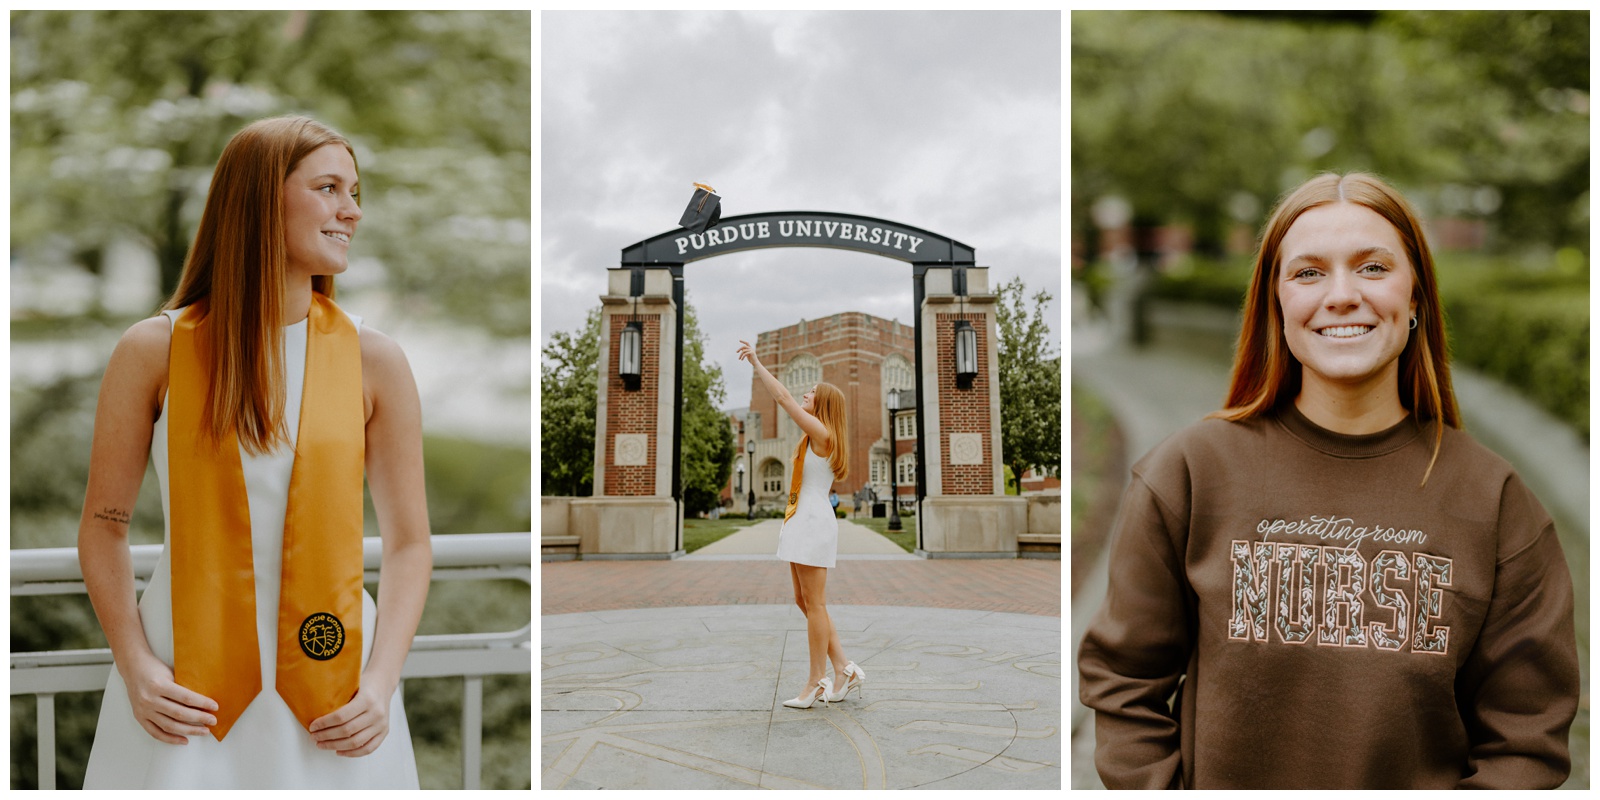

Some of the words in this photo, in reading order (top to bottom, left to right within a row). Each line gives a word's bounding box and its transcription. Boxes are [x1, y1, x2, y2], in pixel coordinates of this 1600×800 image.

[674, 221, 770, 254] PURDUE
[778, 220, 924, 254] UNIVERSITY
[1228, 540, 1453, 655] NURSE
